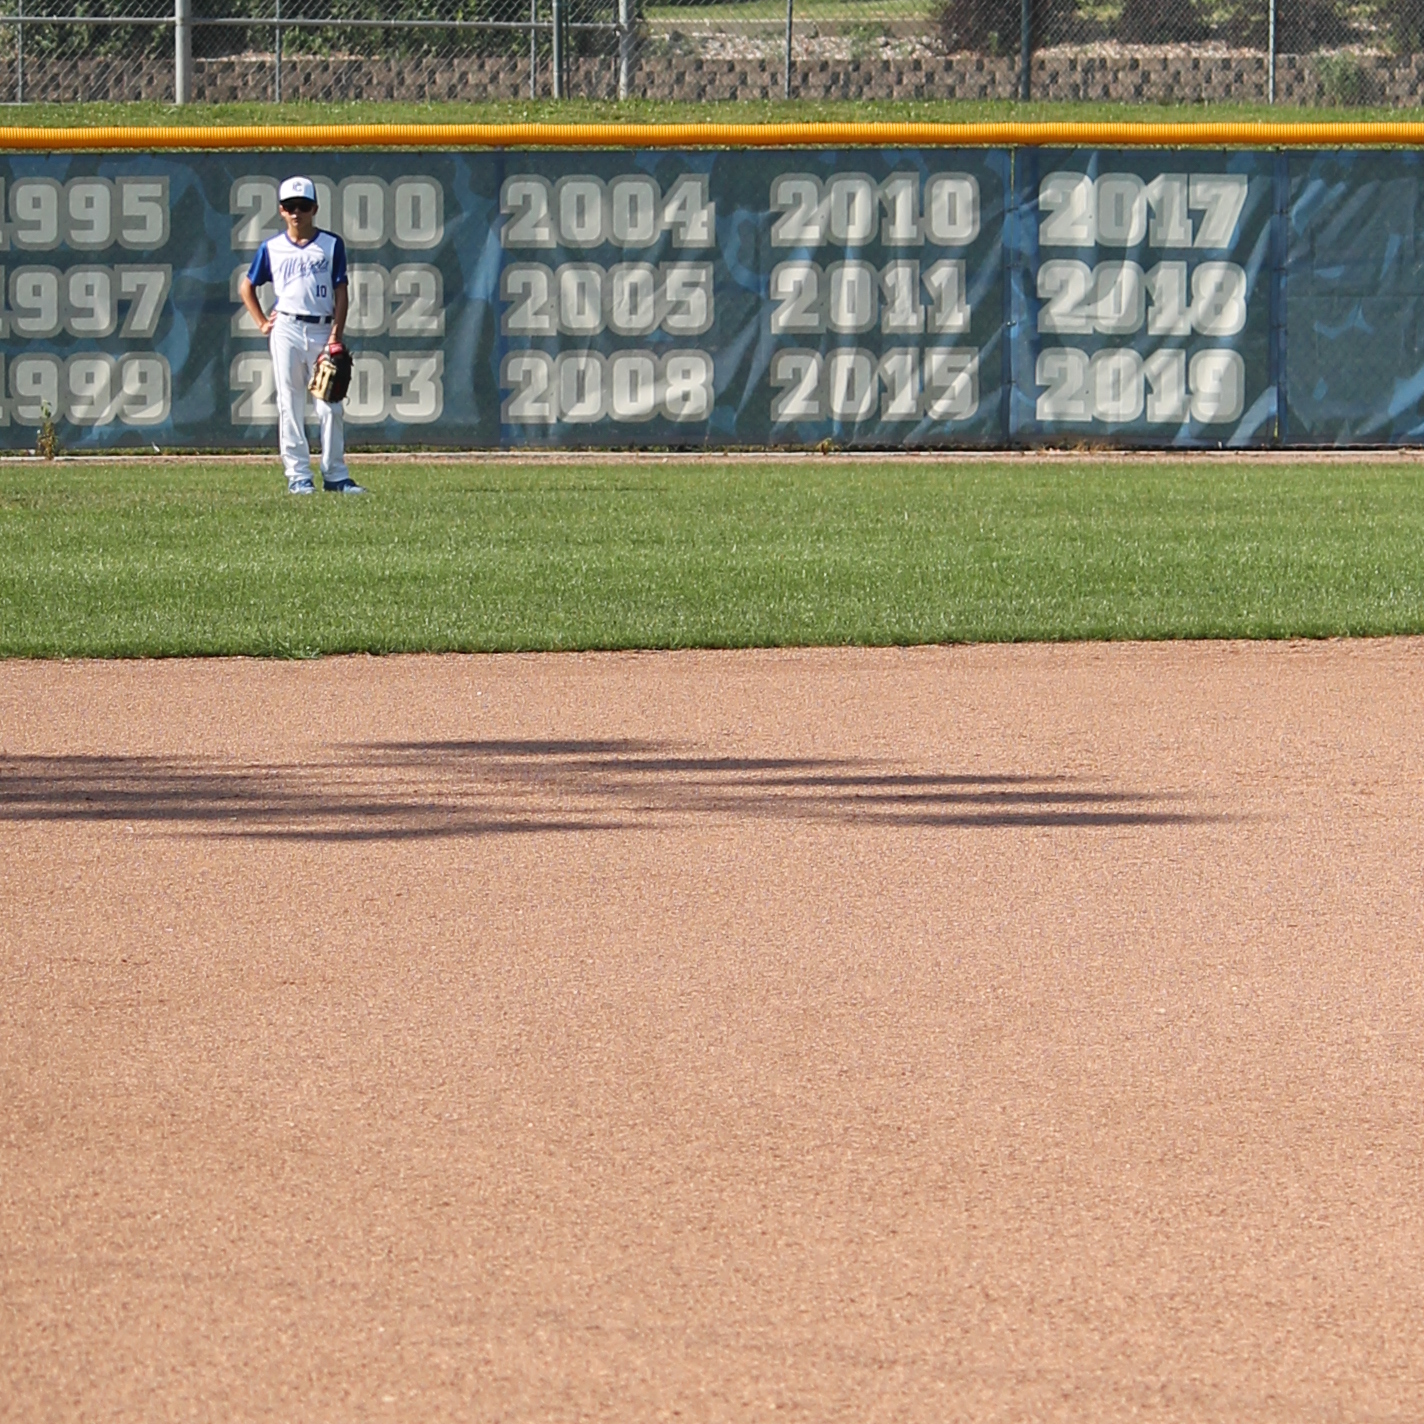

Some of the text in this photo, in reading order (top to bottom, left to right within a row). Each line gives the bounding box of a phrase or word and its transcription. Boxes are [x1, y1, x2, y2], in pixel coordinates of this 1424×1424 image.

[501, 176, 715, 248] 2004
[770, 172, 980, 247] 2010
[1039, 171, 1248, 248] 2017
[315, 285, 327, 298] 10
[501, 262, 715, 336] 2005
[770, 259, 972, 334] 2011
[1037, 259, 1248, 336] 2018
[230, 351, 444, 425] 203
[501, 350, 715, 423] 2008
[770, 347, 979, 421] 2015
[1036, 347, 1245, 423] 2019
